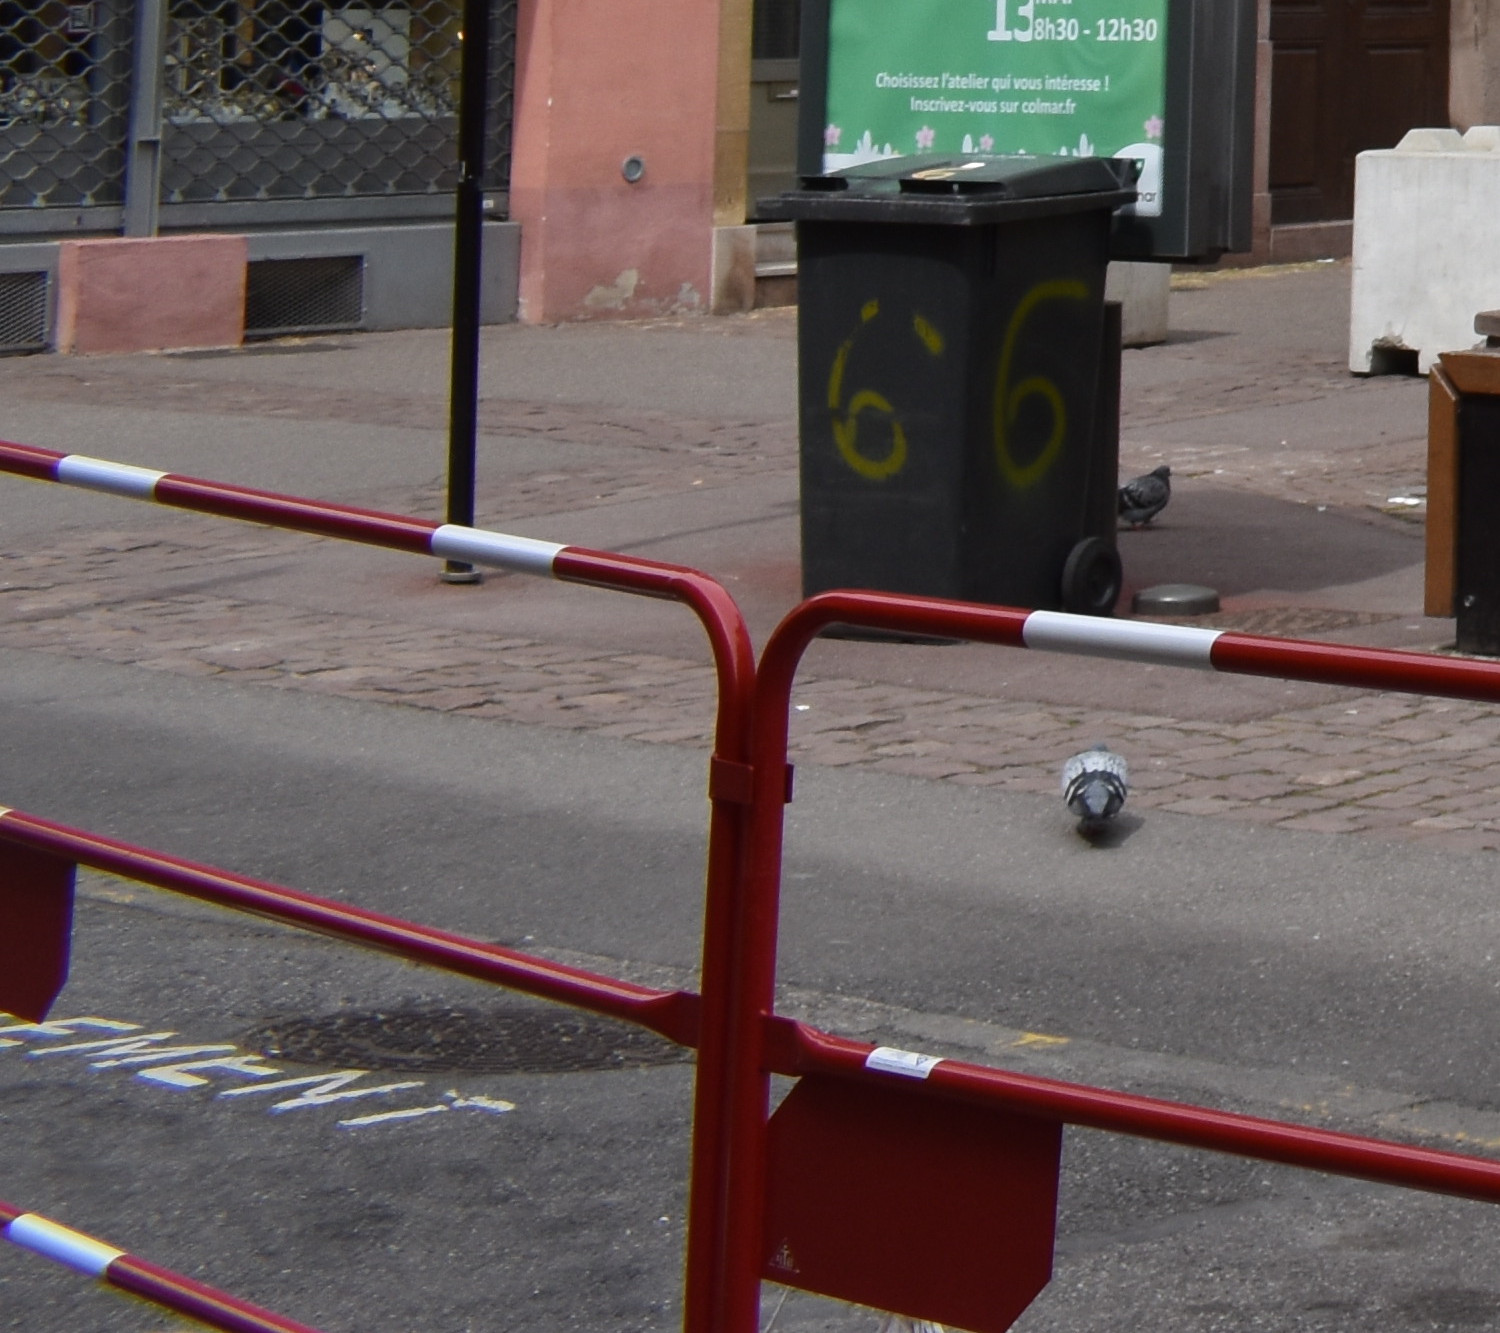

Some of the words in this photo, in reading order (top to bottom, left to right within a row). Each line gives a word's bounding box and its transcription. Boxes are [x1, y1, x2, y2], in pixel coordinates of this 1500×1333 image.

[1034, 17, 1079, 41] 8h30
[1096, 18, 1157, 41] 12h30
[875, 72, 938, 89] Choisissez
[941, 72, 988, 90] l'atelier
[991, 73, 1011, 93] qui
[1013, 77, 1042, 91] vous
[1045, 73, 1101, 91] intéresse
[910, 96, 996, 113] Inscrivez-vous
[1000, 100, 1018, 113] sur
[1022, 97, 1076, 115] colmar.fr
